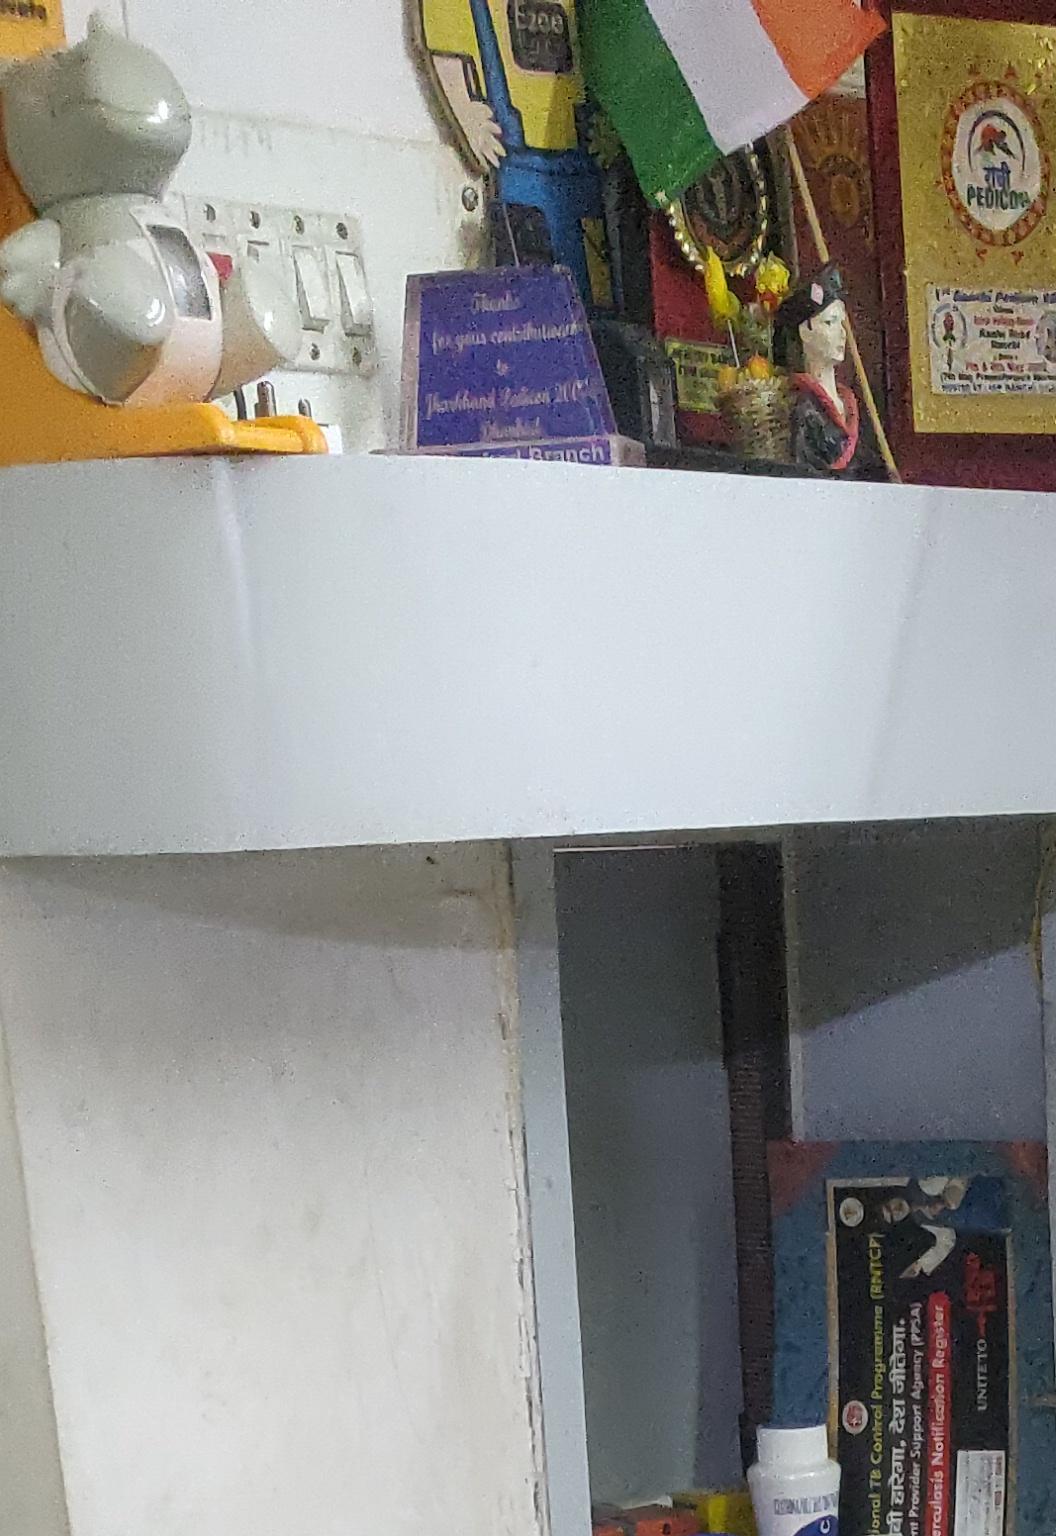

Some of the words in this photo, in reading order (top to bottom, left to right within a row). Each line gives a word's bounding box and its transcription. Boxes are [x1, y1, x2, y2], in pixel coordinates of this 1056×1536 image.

[931, 1304, 947, 1368] Register
[911, 1349, 924, 1400] Agency
[870, 1404, 882, 1464] Control
[910, 1404, 924, 1459] Support
[930, 1373, 945, 1467] Notification
[867, 1494, 882, 1535] ional
[909, 1462, 921, 1518] Provider
